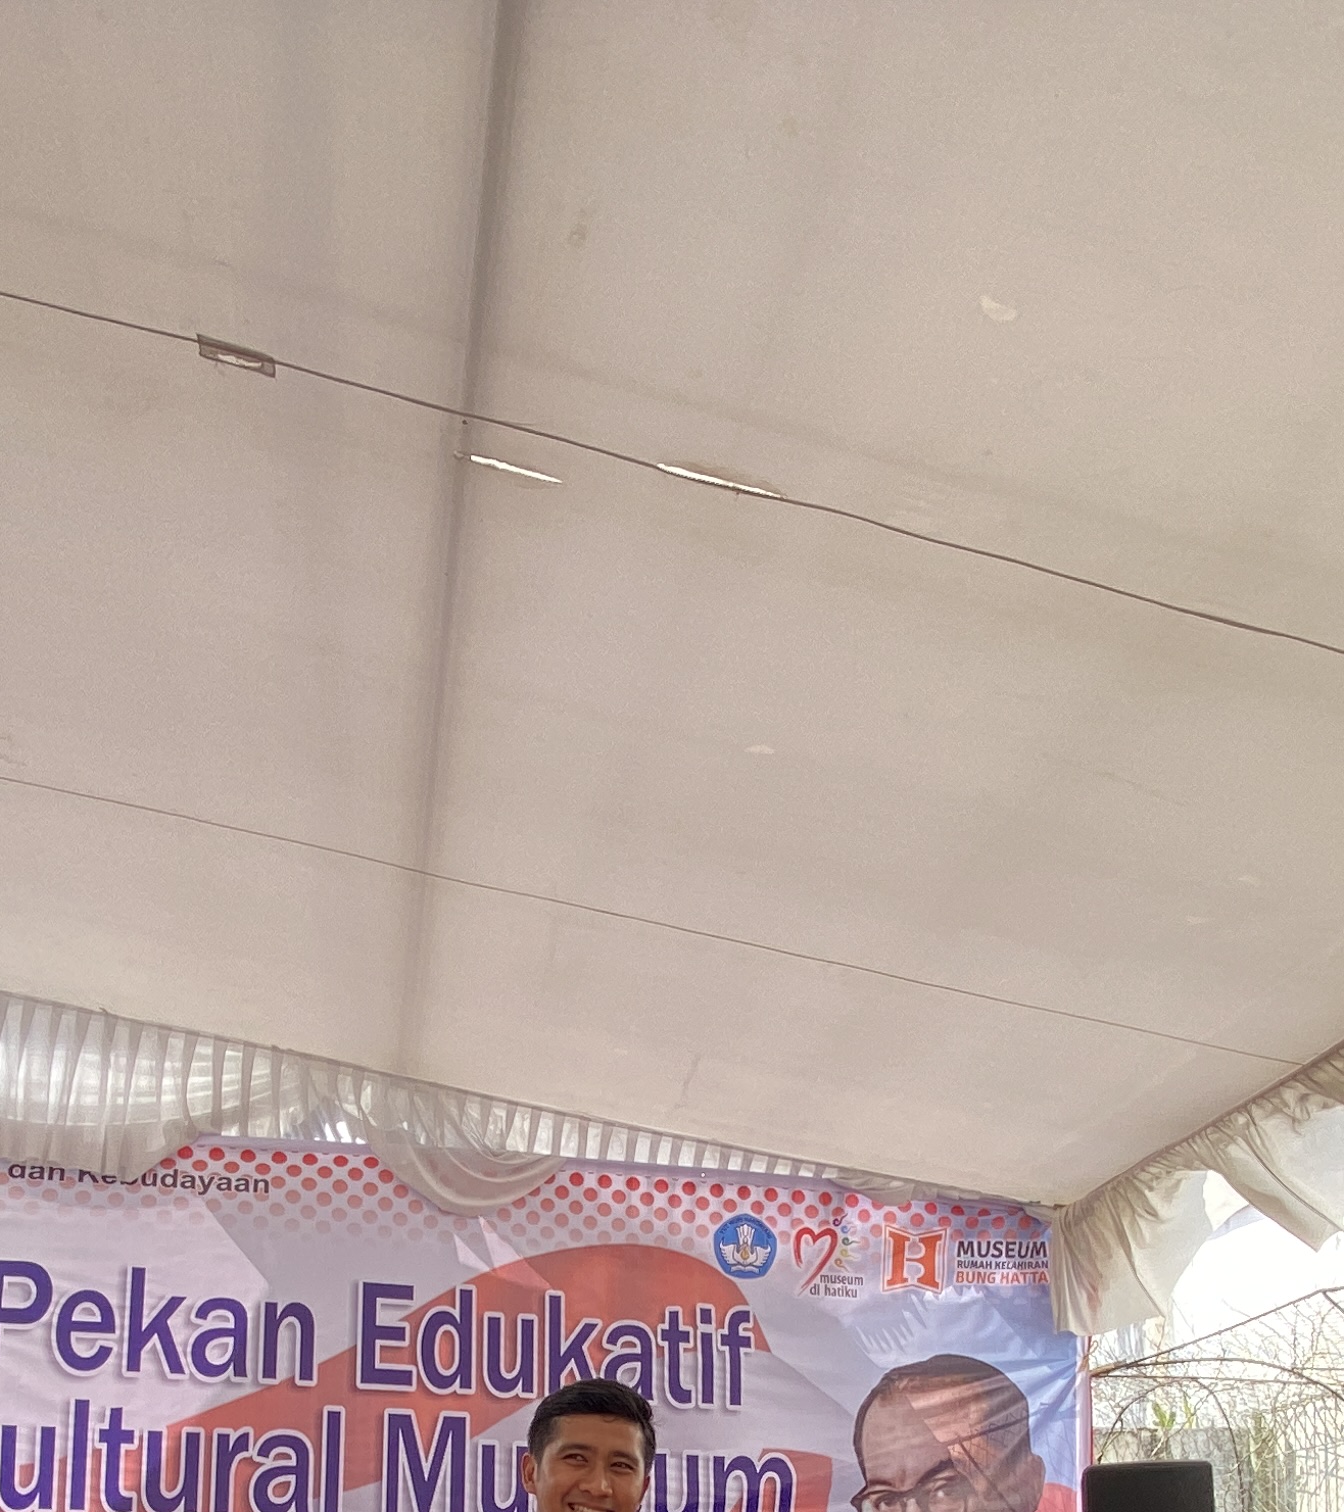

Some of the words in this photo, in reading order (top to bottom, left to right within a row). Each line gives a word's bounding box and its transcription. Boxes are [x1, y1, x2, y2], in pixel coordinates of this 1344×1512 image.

[956, 1240, 1048, 1259] MUSEUM
[957, 1260, 992, 1271] RUMAH
[994, 1260, 1048, 1271] KELAHIRAN
[820, 1273, 864, 1287] museum
[956, 1271, 996, 1284] BUNG
[999, 1271, 1049, 1284] HATTA
[824, 1284, 858, 1299] hatiku
[358, 1281, 755, 1407] Edukatif
